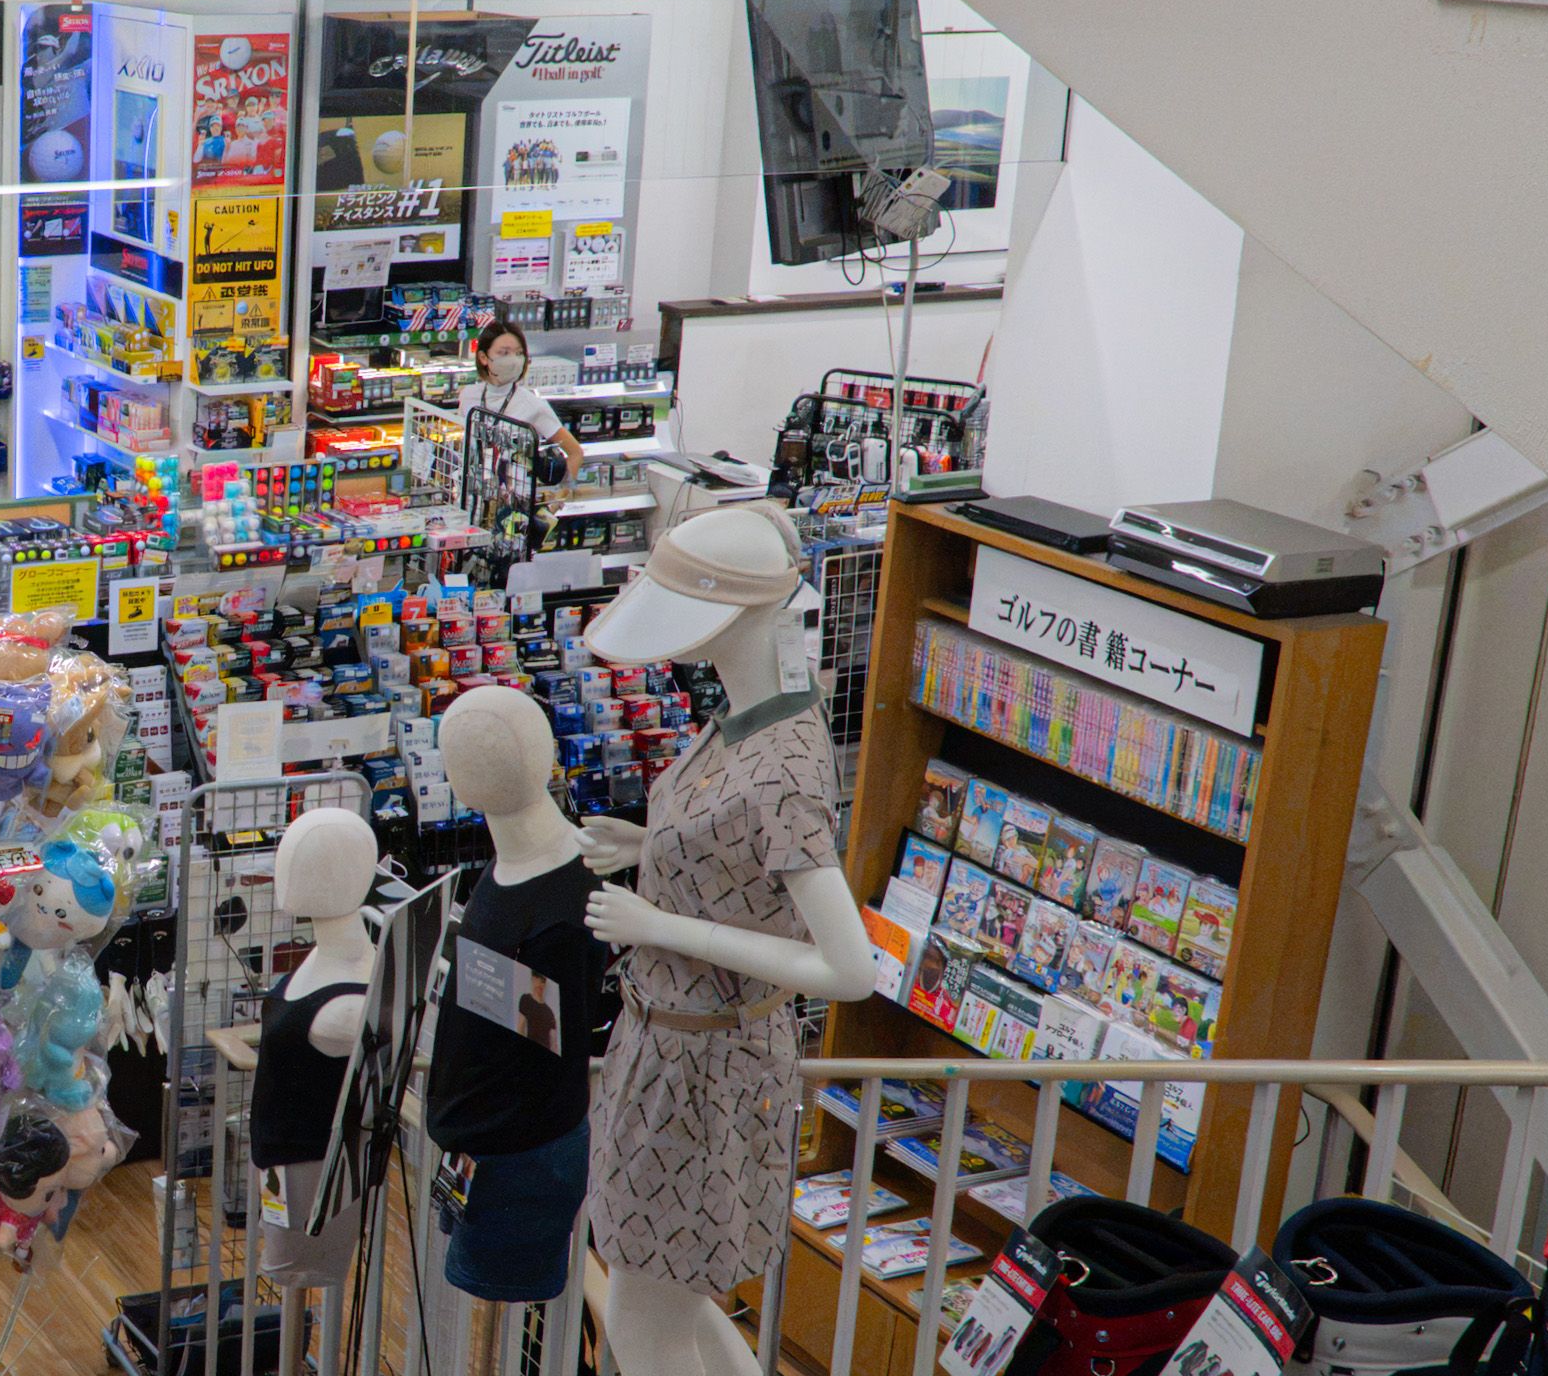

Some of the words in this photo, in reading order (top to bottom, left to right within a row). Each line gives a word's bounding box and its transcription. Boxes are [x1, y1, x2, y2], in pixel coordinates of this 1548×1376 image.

[369, 45, 487, 77] Calaway
[515, 32, 620, 69] Titleist
[196, 56, 286, 100] SRIXON
[214, 205, 260, 215] CAUTION
[333, 207, 394, 221] ディスタンス
[336, 190, 397, 207] ドライビング
[197, 263, 210, 274] DO
[212, 262, 233, 273] NOT
[235, 261, 252, 272] HIT
[254, 260, 274, 271] UFO
[998, 595, 1215, 694] ゴルフの書籍コーナー
[1254, 1270, 1297, 1323] TaylorMade
